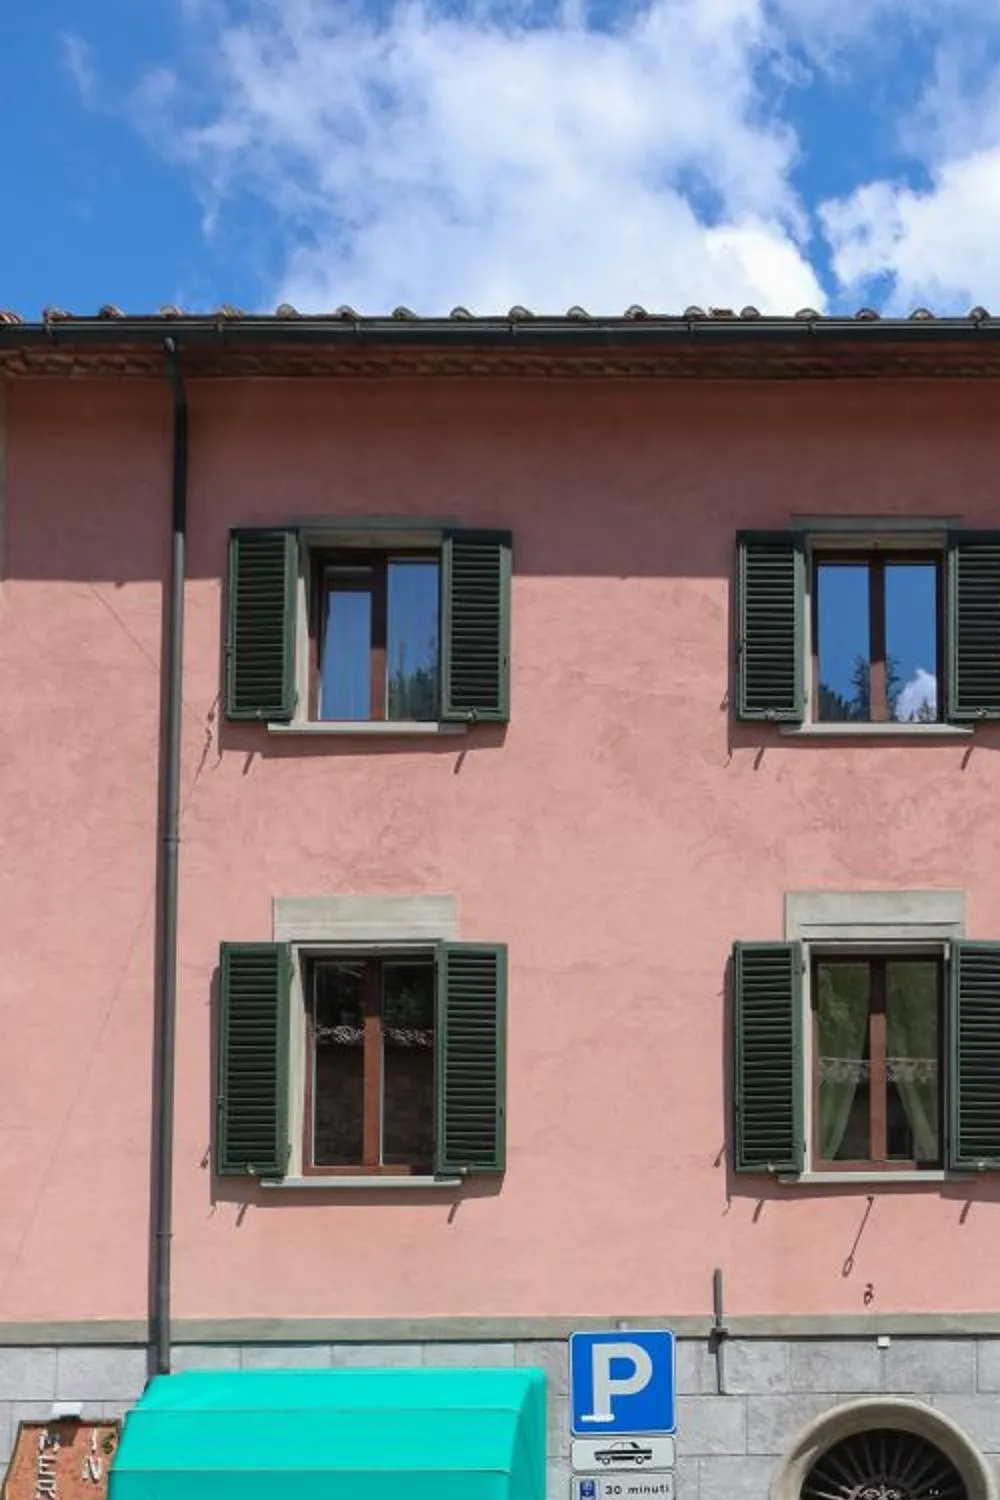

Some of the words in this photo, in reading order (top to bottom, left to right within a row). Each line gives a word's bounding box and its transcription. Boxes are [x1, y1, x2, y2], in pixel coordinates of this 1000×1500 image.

[590, 1342, 654, 1420] P
[82, 1427, 102, 1484] IN
[604, 1484, 623, 1496] 30
[627, 1482, 670, 1496] minuti
